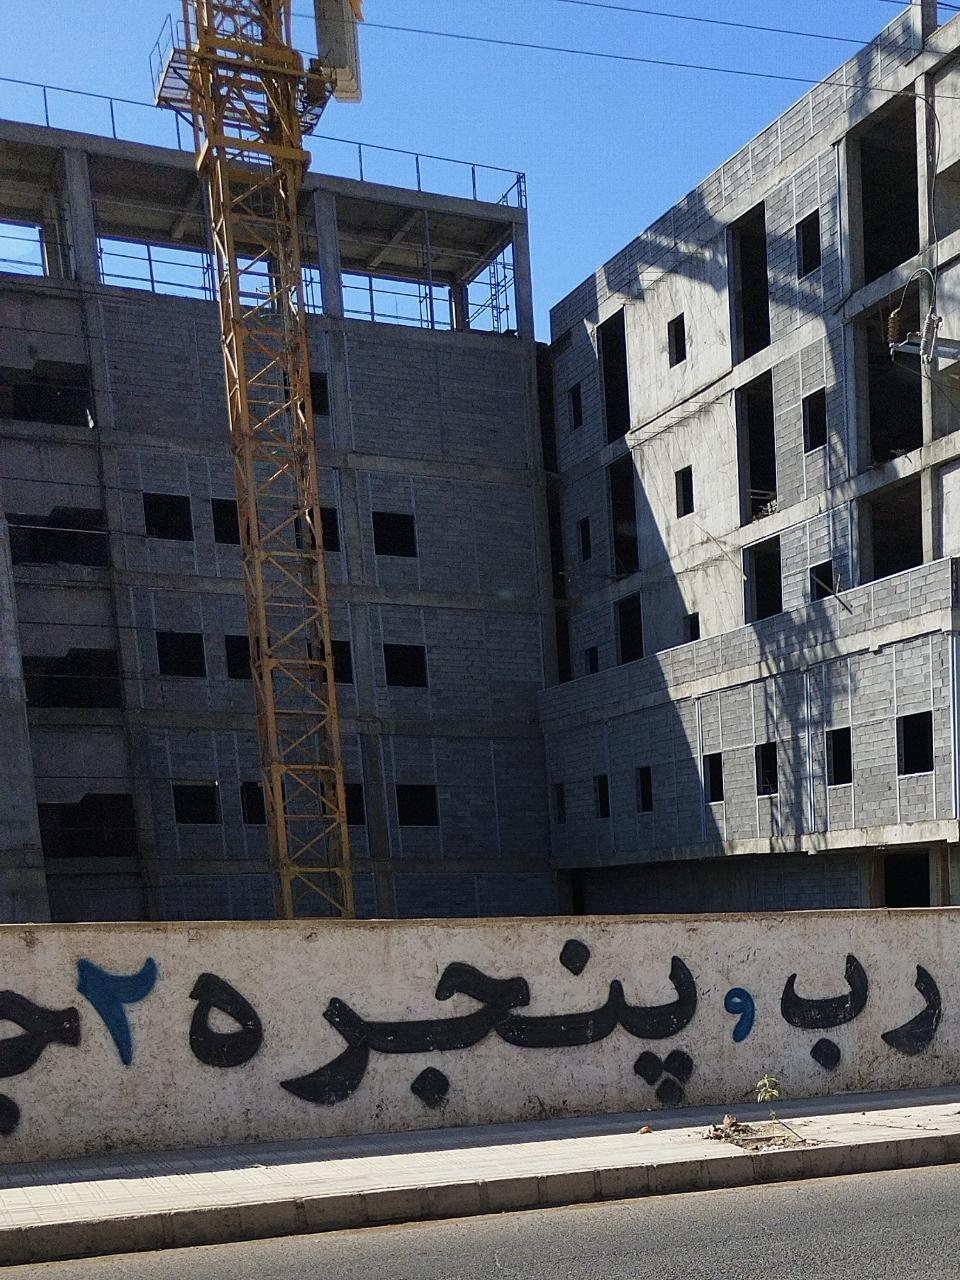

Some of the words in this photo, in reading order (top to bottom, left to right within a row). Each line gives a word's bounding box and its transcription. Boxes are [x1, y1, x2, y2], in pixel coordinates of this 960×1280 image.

[77, 957, 158, 1066] ۲
[190, 939, 698, 1108] پنجره
[724, 986, 756, 1043] و
